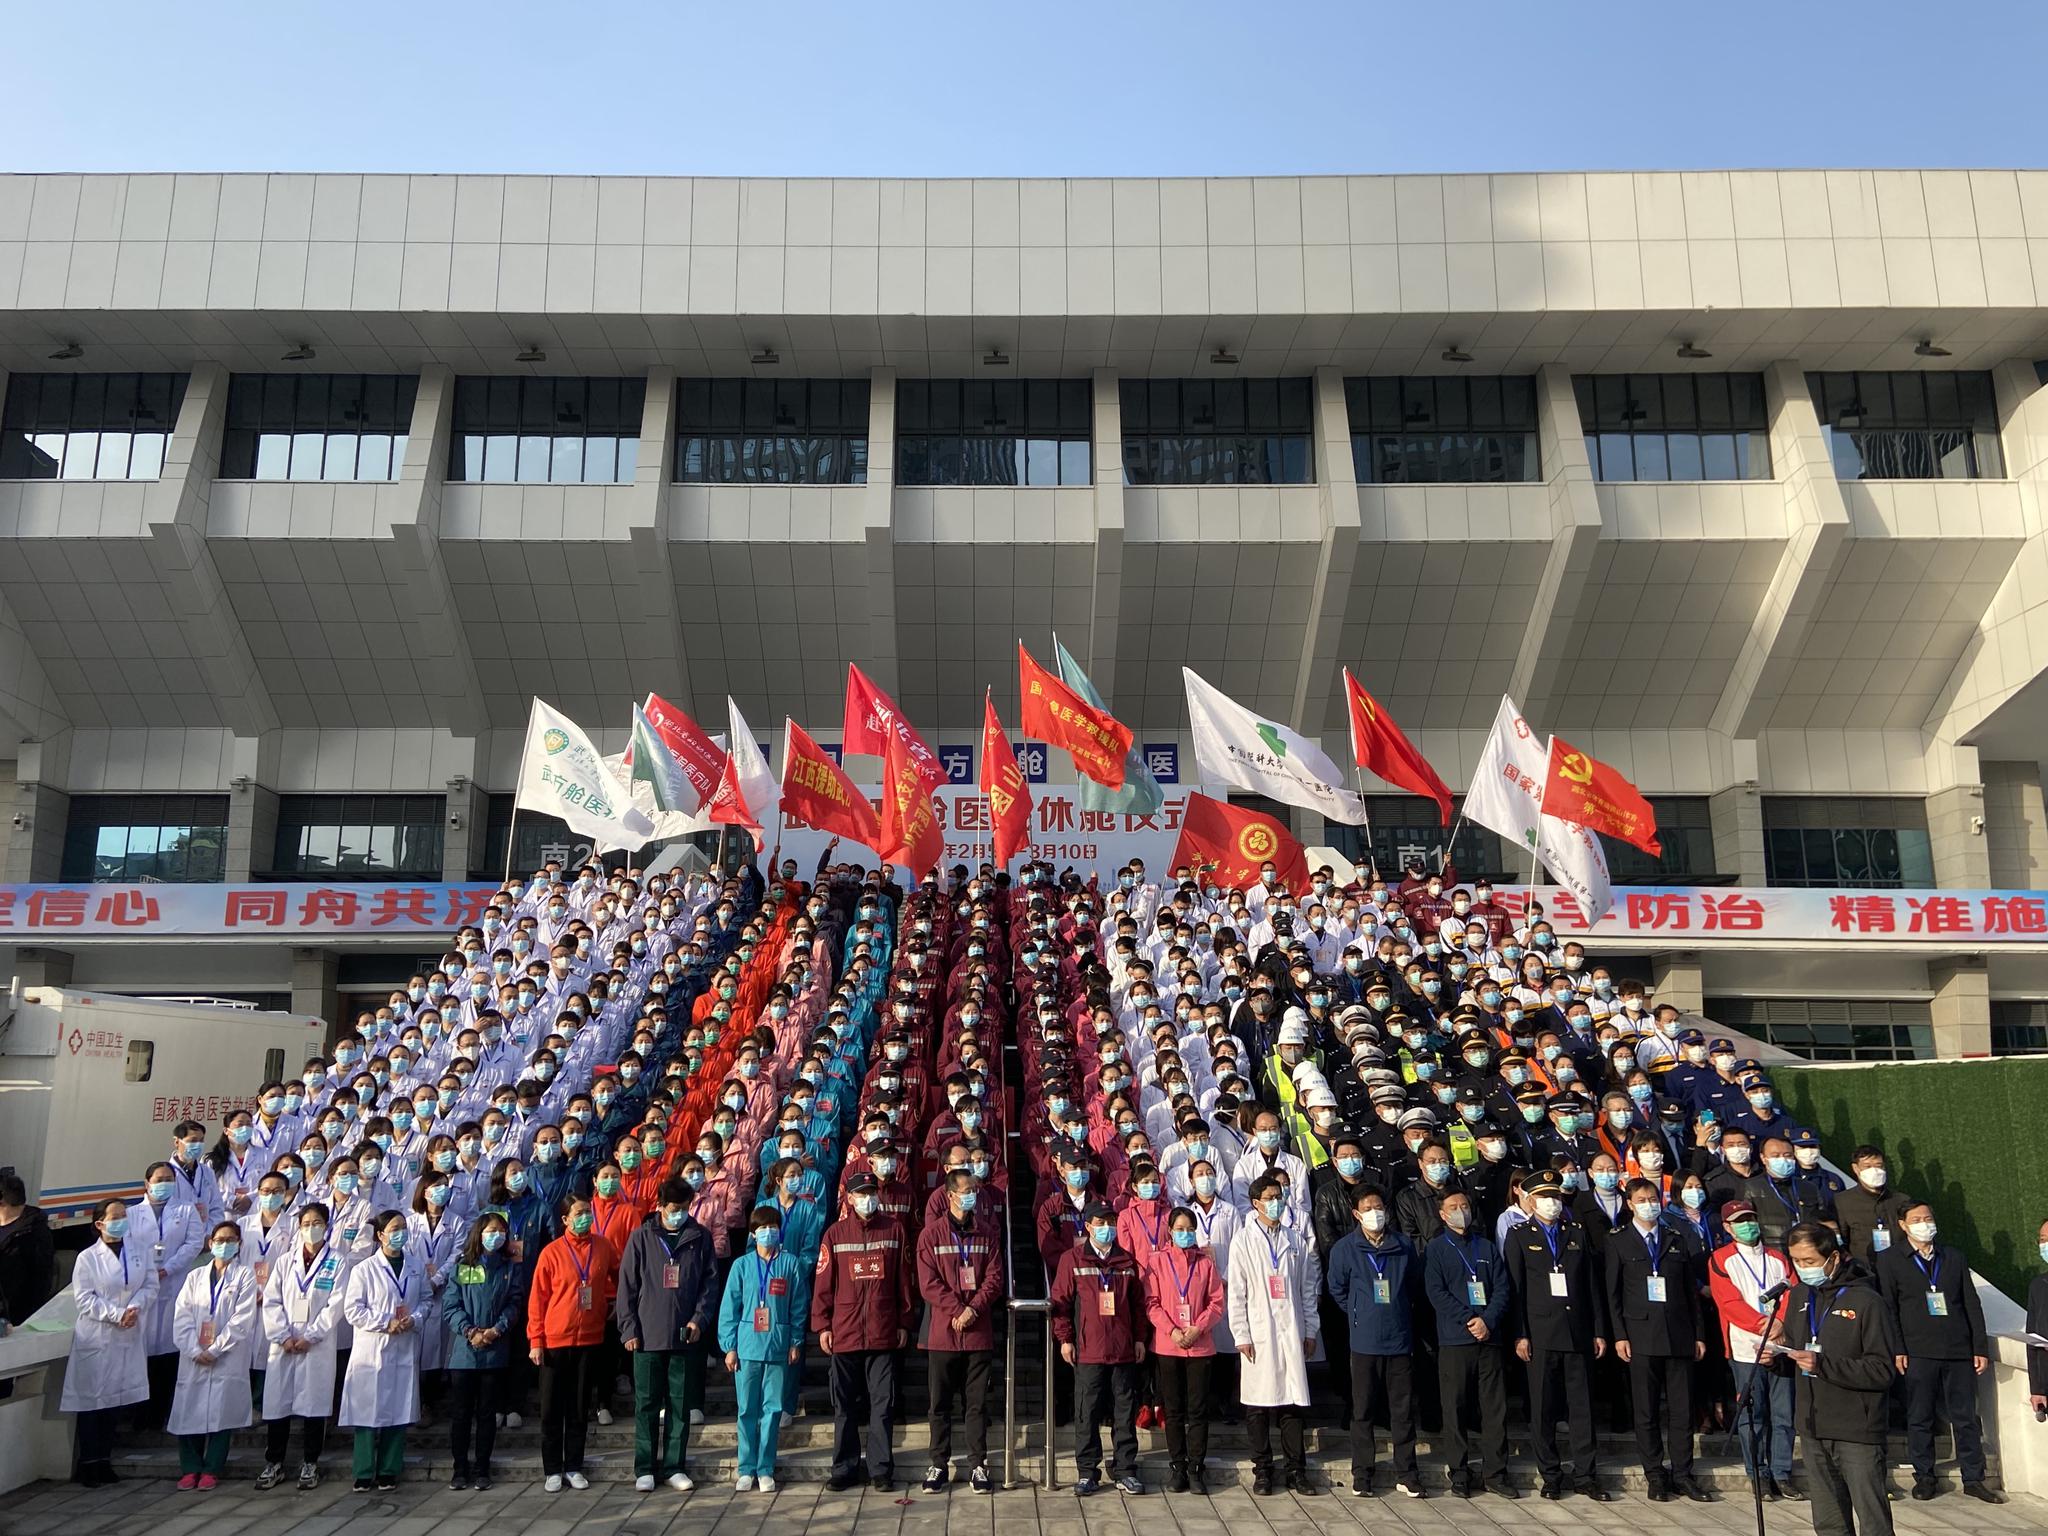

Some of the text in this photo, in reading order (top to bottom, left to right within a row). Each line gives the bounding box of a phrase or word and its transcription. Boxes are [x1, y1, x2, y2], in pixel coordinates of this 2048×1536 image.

[1148, 751, 1175, 776] 医
[1828, 895, 2048, 934] 精准施
[86, 1031, 125, 1049] 中国卫生
